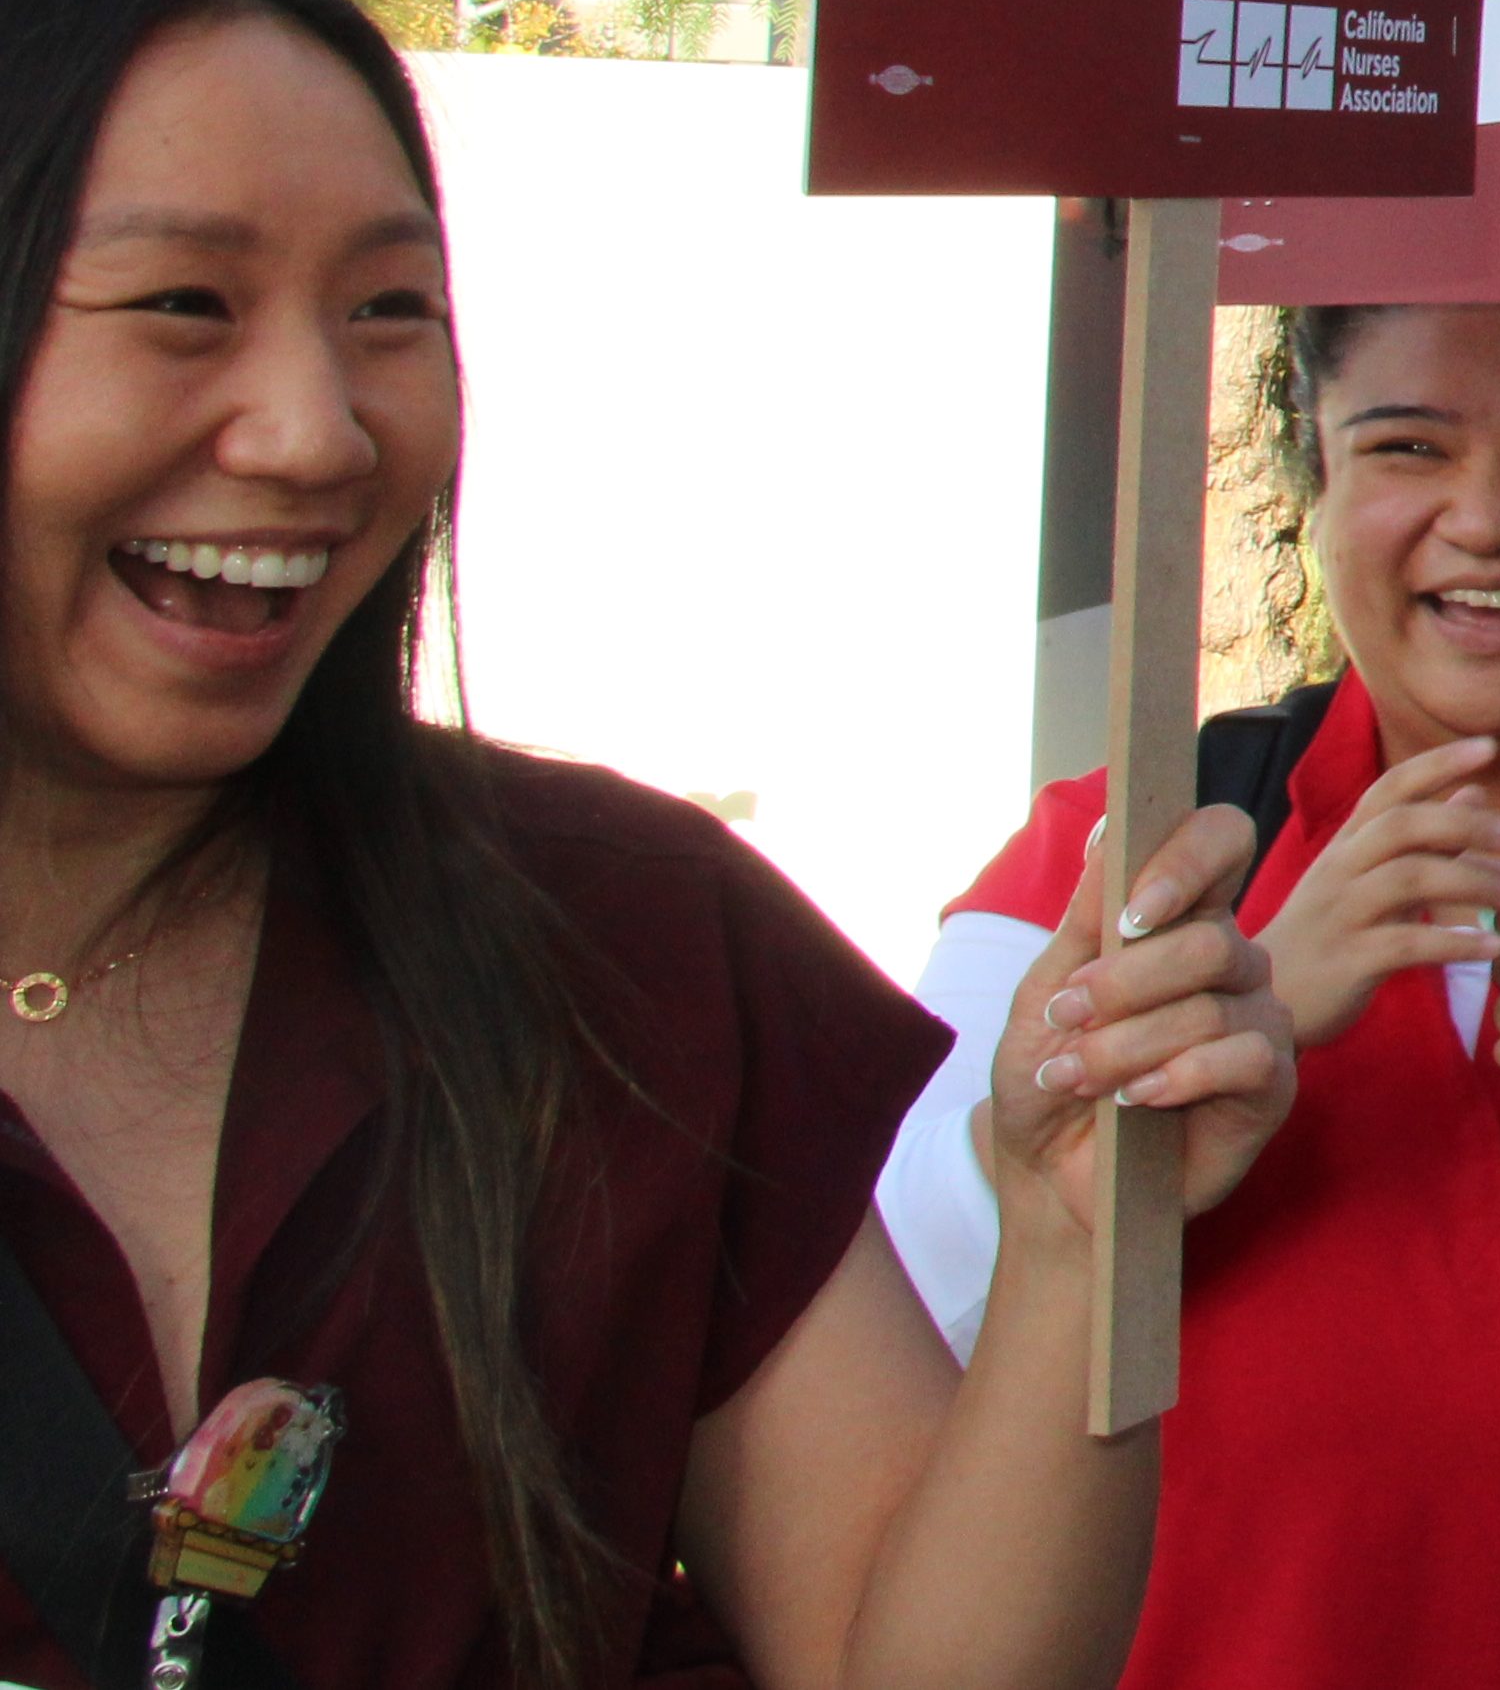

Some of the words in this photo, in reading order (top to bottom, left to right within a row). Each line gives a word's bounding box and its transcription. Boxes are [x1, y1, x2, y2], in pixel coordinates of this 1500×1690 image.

[1343, 9, 1426, 45] California
[1341, 46, 1401, 78] Nurses
[1339, 83, 1439, 115] Association
